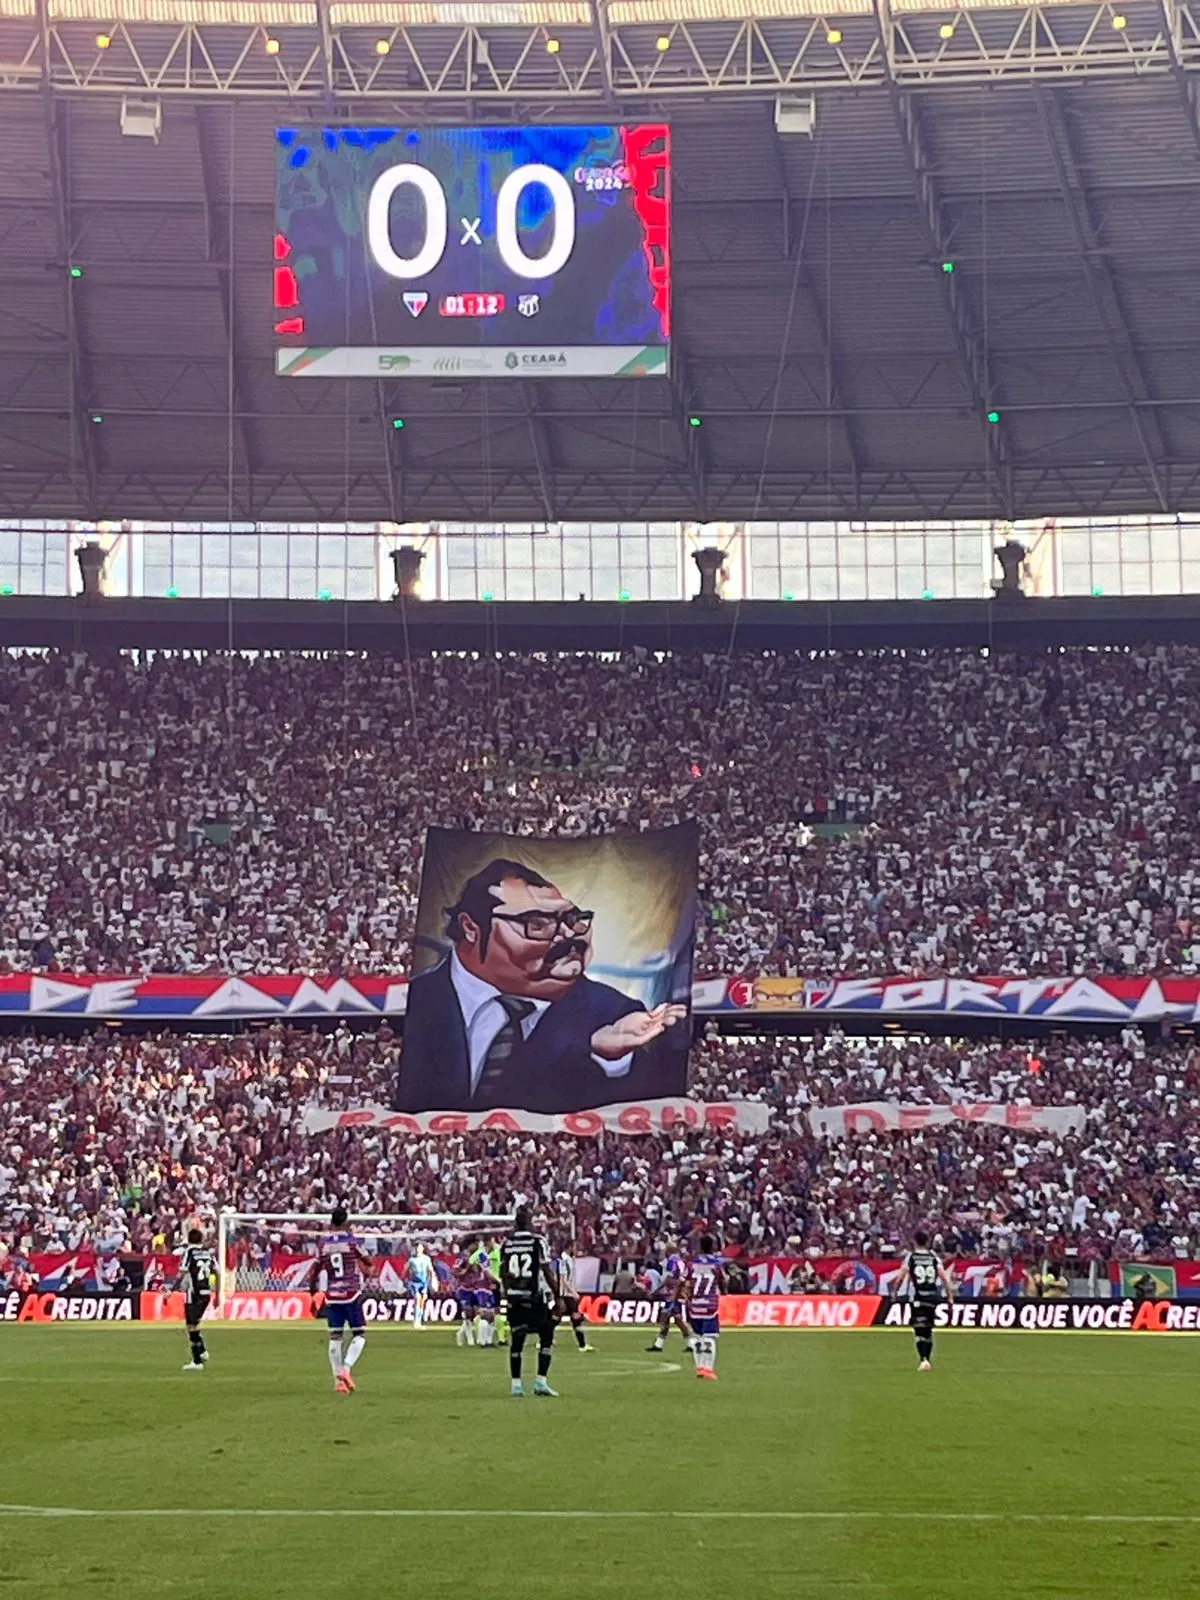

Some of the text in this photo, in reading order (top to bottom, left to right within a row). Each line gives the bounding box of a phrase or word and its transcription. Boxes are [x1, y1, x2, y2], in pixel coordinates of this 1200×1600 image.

[367, 163, 448, 279] 0
[496, 163, 576, 279] 0
[445, 295, 498, 314] 01:12
[522, 351, 567, 364] CEARÁ
[826, 975, 1200, 1022] FORTAL
[331, 1253, 344, 1278] 9
[508, 1253, 533, 1278] 42
[913, 1265, 936, 1284] 99
[691, 1272, 716, 1296] 77
[18, 1293, 132, 1324] ACREDITA
[362, 1298, 458, 1321] OSTE NO
[578, 1296, 665, 1323] ACREDI
[743, 1300, 860, 1326] BETANO
[884, 1298, 1200, 1331] ASTE NO QUE VOCÊ ACRE
